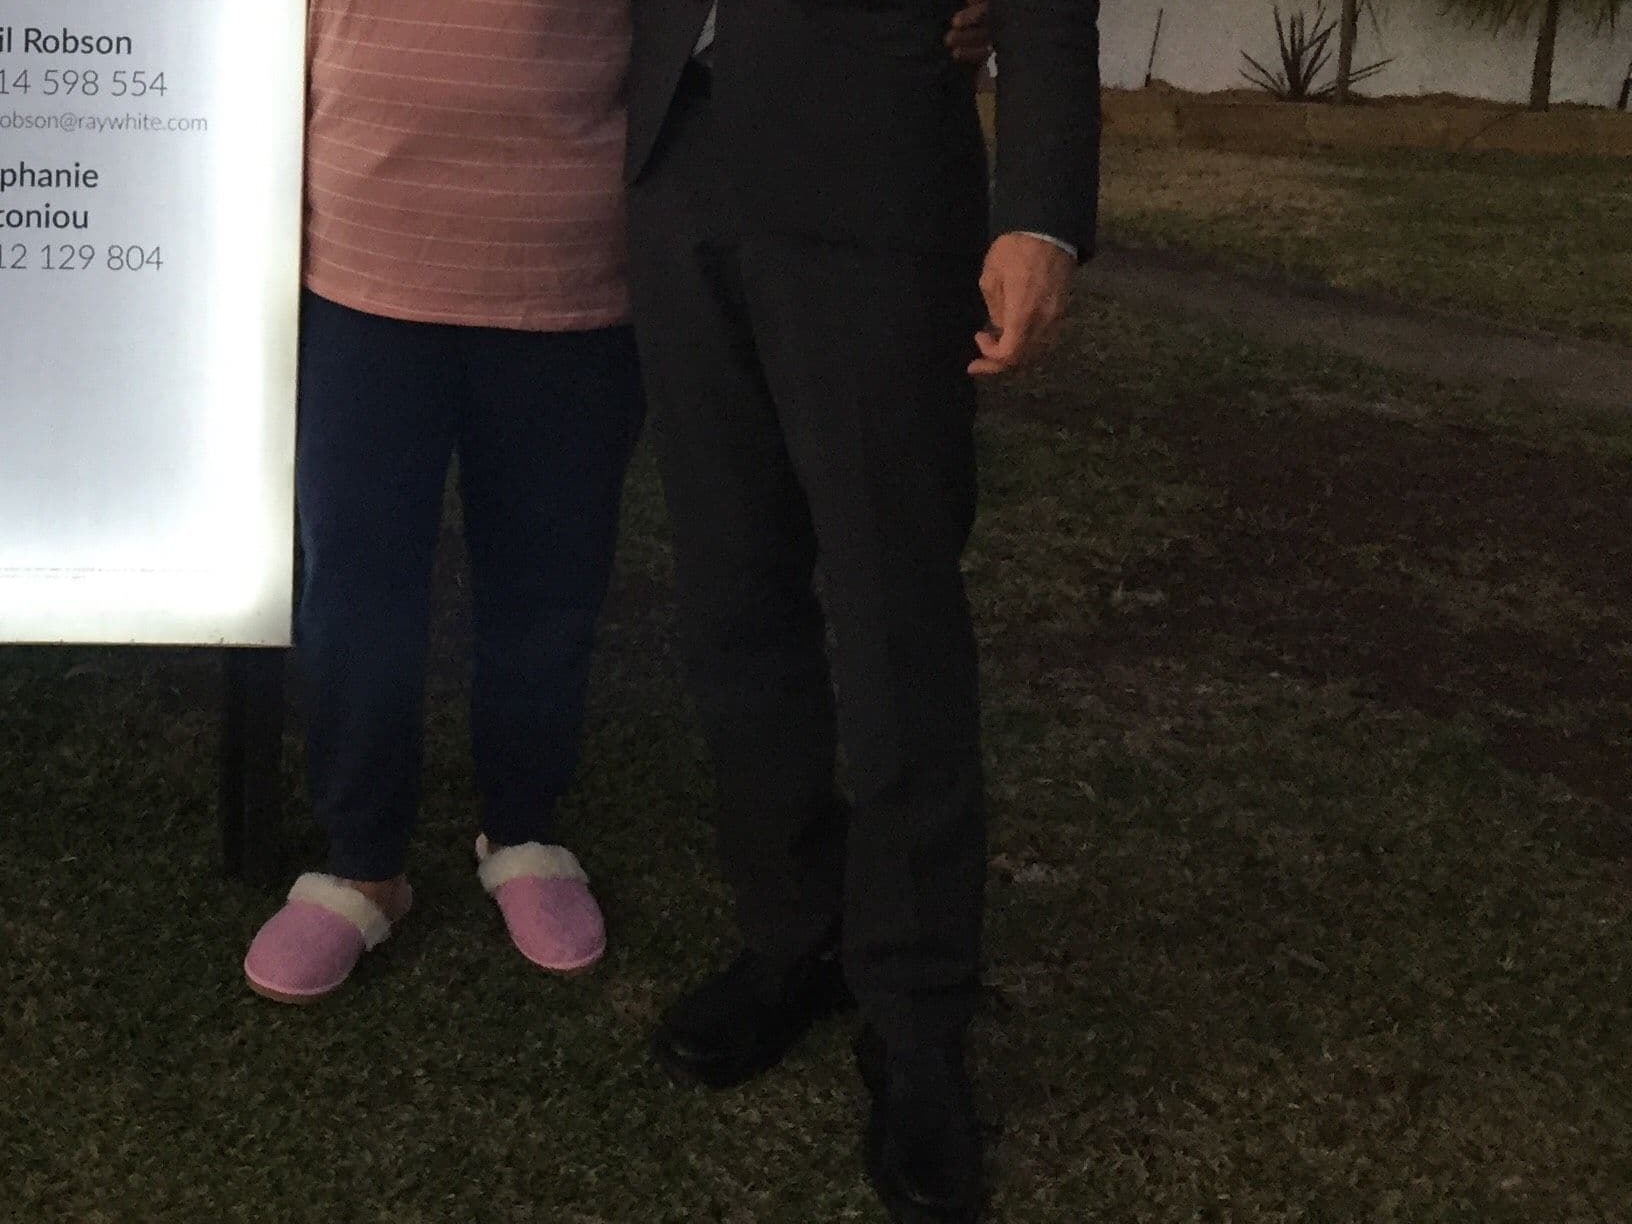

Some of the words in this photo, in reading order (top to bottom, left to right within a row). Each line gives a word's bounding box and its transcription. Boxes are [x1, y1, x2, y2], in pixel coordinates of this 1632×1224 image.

[23, 26, 132, 55] Robson
[42, 68, 99, 97] 598
[110, 70, 169, 97] 554
[40, 243, 96, 271] 129
[106, 244, 165, 272] 804
